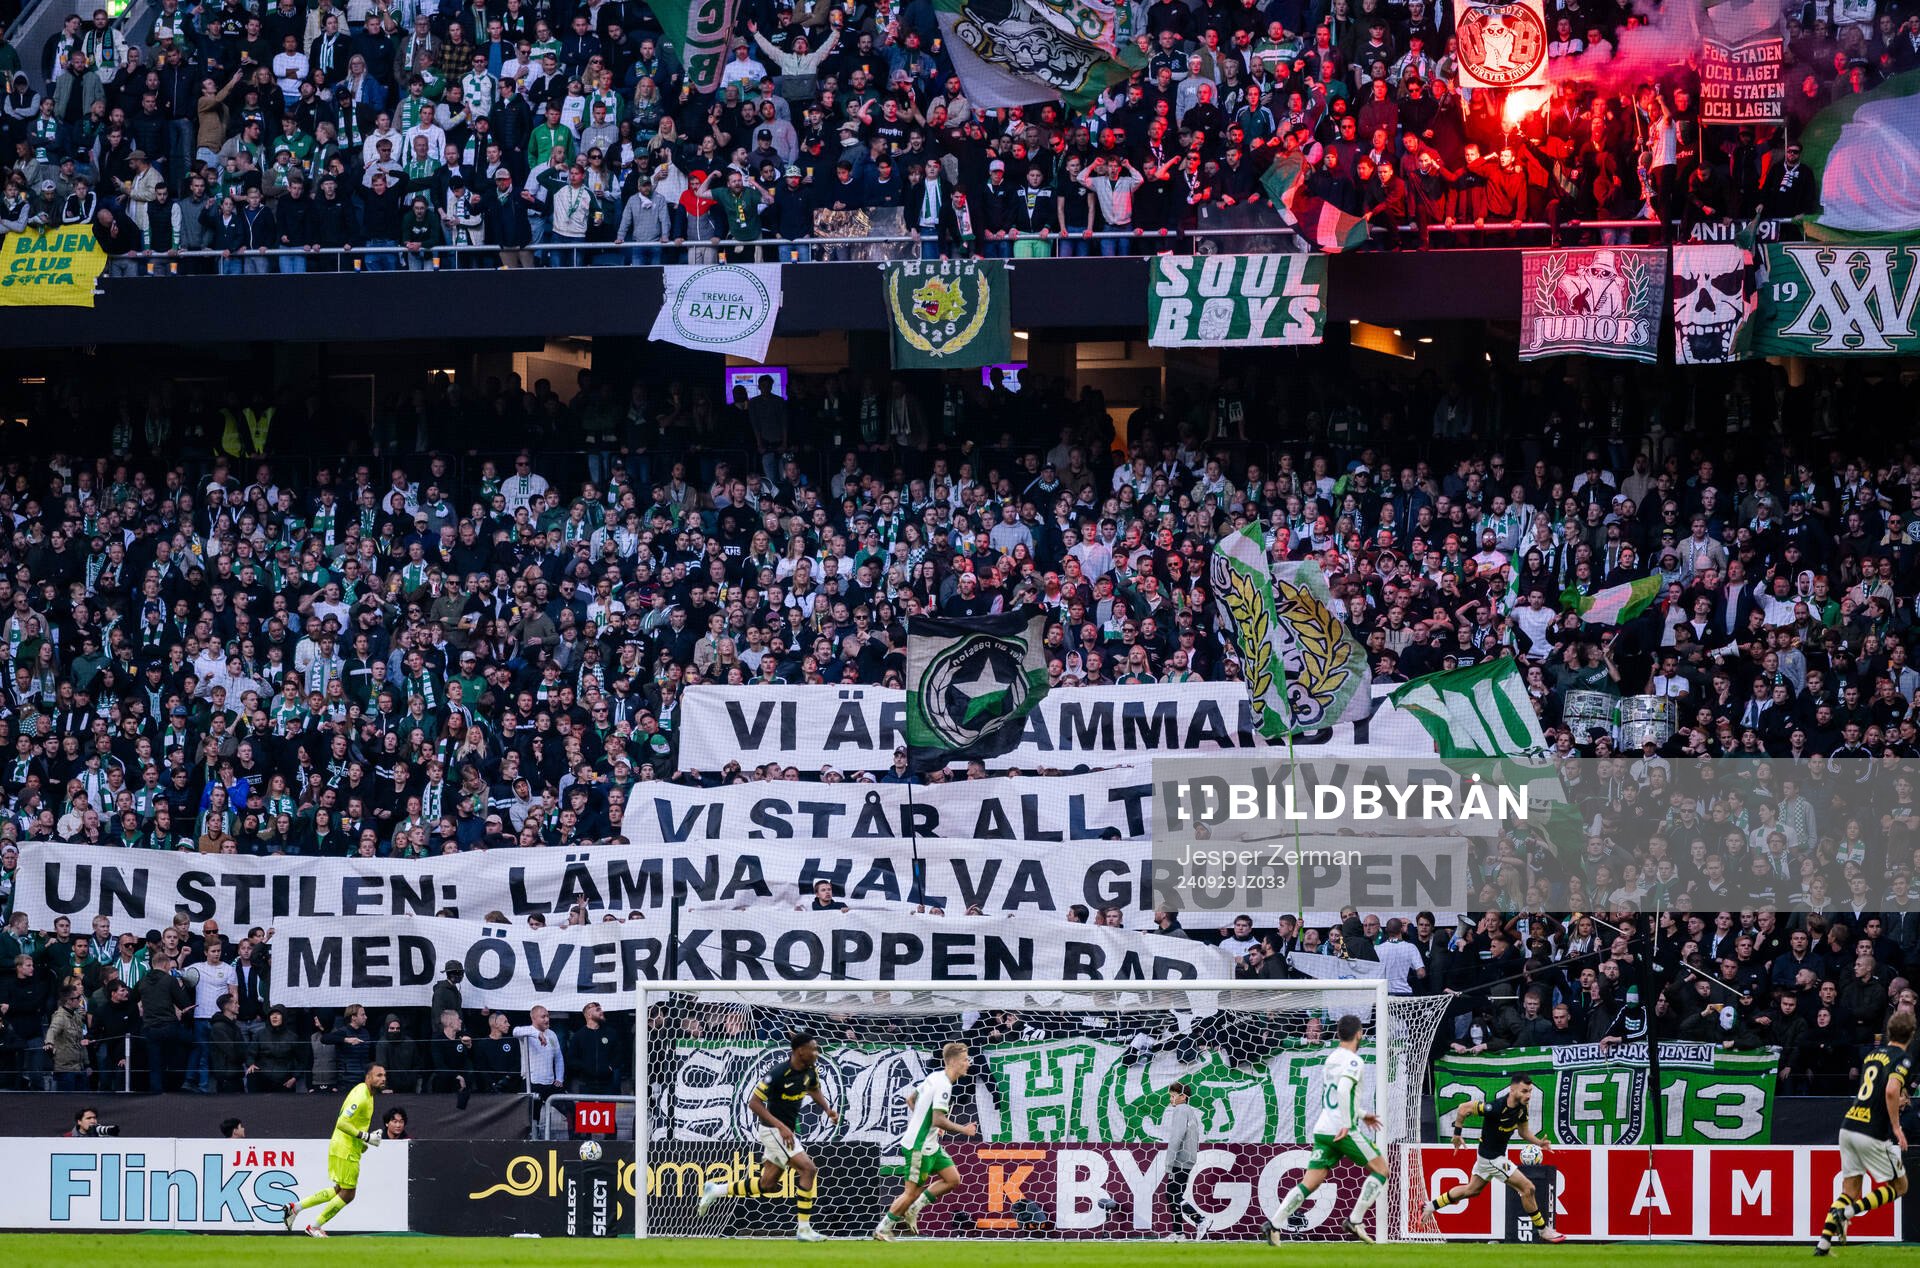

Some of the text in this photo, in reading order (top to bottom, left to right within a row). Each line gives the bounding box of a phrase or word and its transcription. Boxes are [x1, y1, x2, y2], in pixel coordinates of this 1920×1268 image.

[1731, 44, 1782, 63] STADEN
[1470, 63, 1506, 81] FOREVER
[1705, 64, 1779, 81] OCH LAGET
[1700, 82, 1785, 99] MOT STATEN
[1704, 101, 1781, 117] OCH LAGEN
[15, 234, 97, 254] BAJEN
[1691, 222, 1735, 240] ANTI
[10, 257, 73, 272] CLUB
[1156, 255, 1320, 297] SOUL
[702, 292, 744, 302] TREVLIGA
[1772, 281, 1799, 302] 19
[689, 303, 753, 321] BAJEN
[1153, 297, 1321, 339] BOYS
[1530, 316, 1650, 349] JUNIORS
[725, 700, 797, 751] VI
[653, 797, 725, 842] VI
[748, 790, 948, 839] STÅR
[44, 853, 1456, 925] UN STILEN: LÄMNA HALVA GRUPPEN
[286, 935, 436, 989] MED
[462, 928, 1035, 993] ÖVERKROPPEN
[1560, 1075, 1570, 1114] CURVA
[1858, 1066, 1878, 1101] 8
[579, 1109, 611, 1127] 101
[1660, 1078, 1767, 1141] 13
[1619, 1114, 1640, 1145] PIRITU
[233, 1146, 295, 1167] JÄRN
[49, 1153, 301, 1224] Flinks
[1056, 1148, 1338, 1231] BYGG
[567, 1178, 577, 1236] SELECT
[592, 1178, 608, 1237] SELECT
